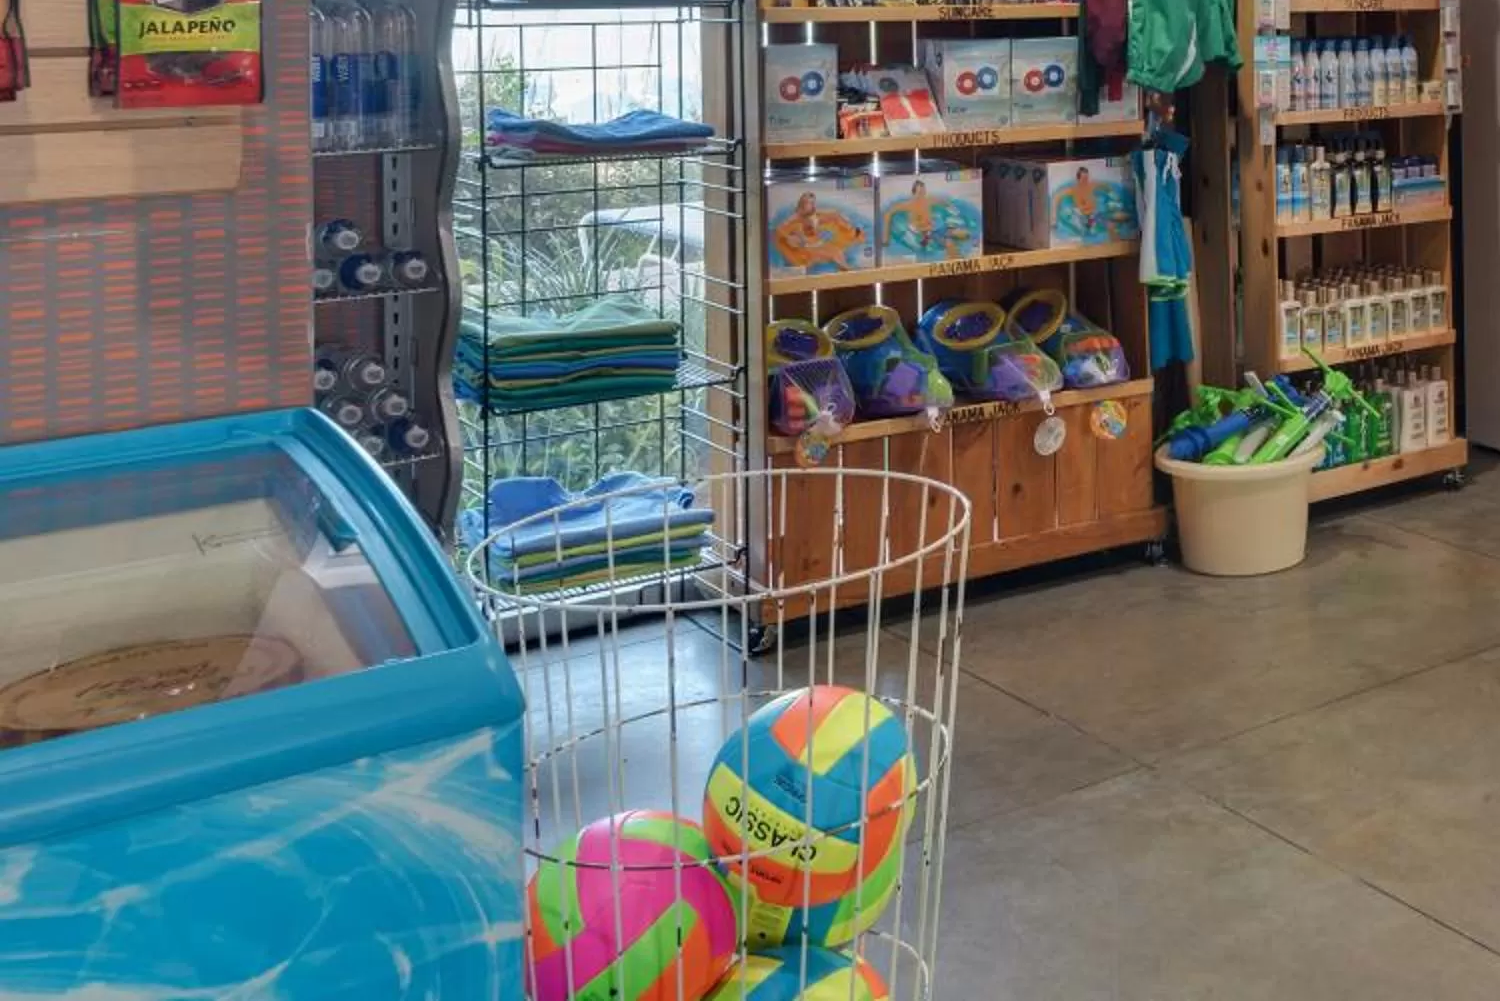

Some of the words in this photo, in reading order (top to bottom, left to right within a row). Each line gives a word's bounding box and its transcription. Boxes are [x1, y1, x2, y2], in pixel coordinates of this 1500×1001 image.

[138, 17, 236, 38] JALAPEÑO
[932, 130, 1000, 148] PRODUCTS
[929, 259, 981, 276] PANAMA
[986, 256, 1016, 271] JACK
[943, 407, 987, 426] ANAMA
[989, 402, 1021, 419] JACK
